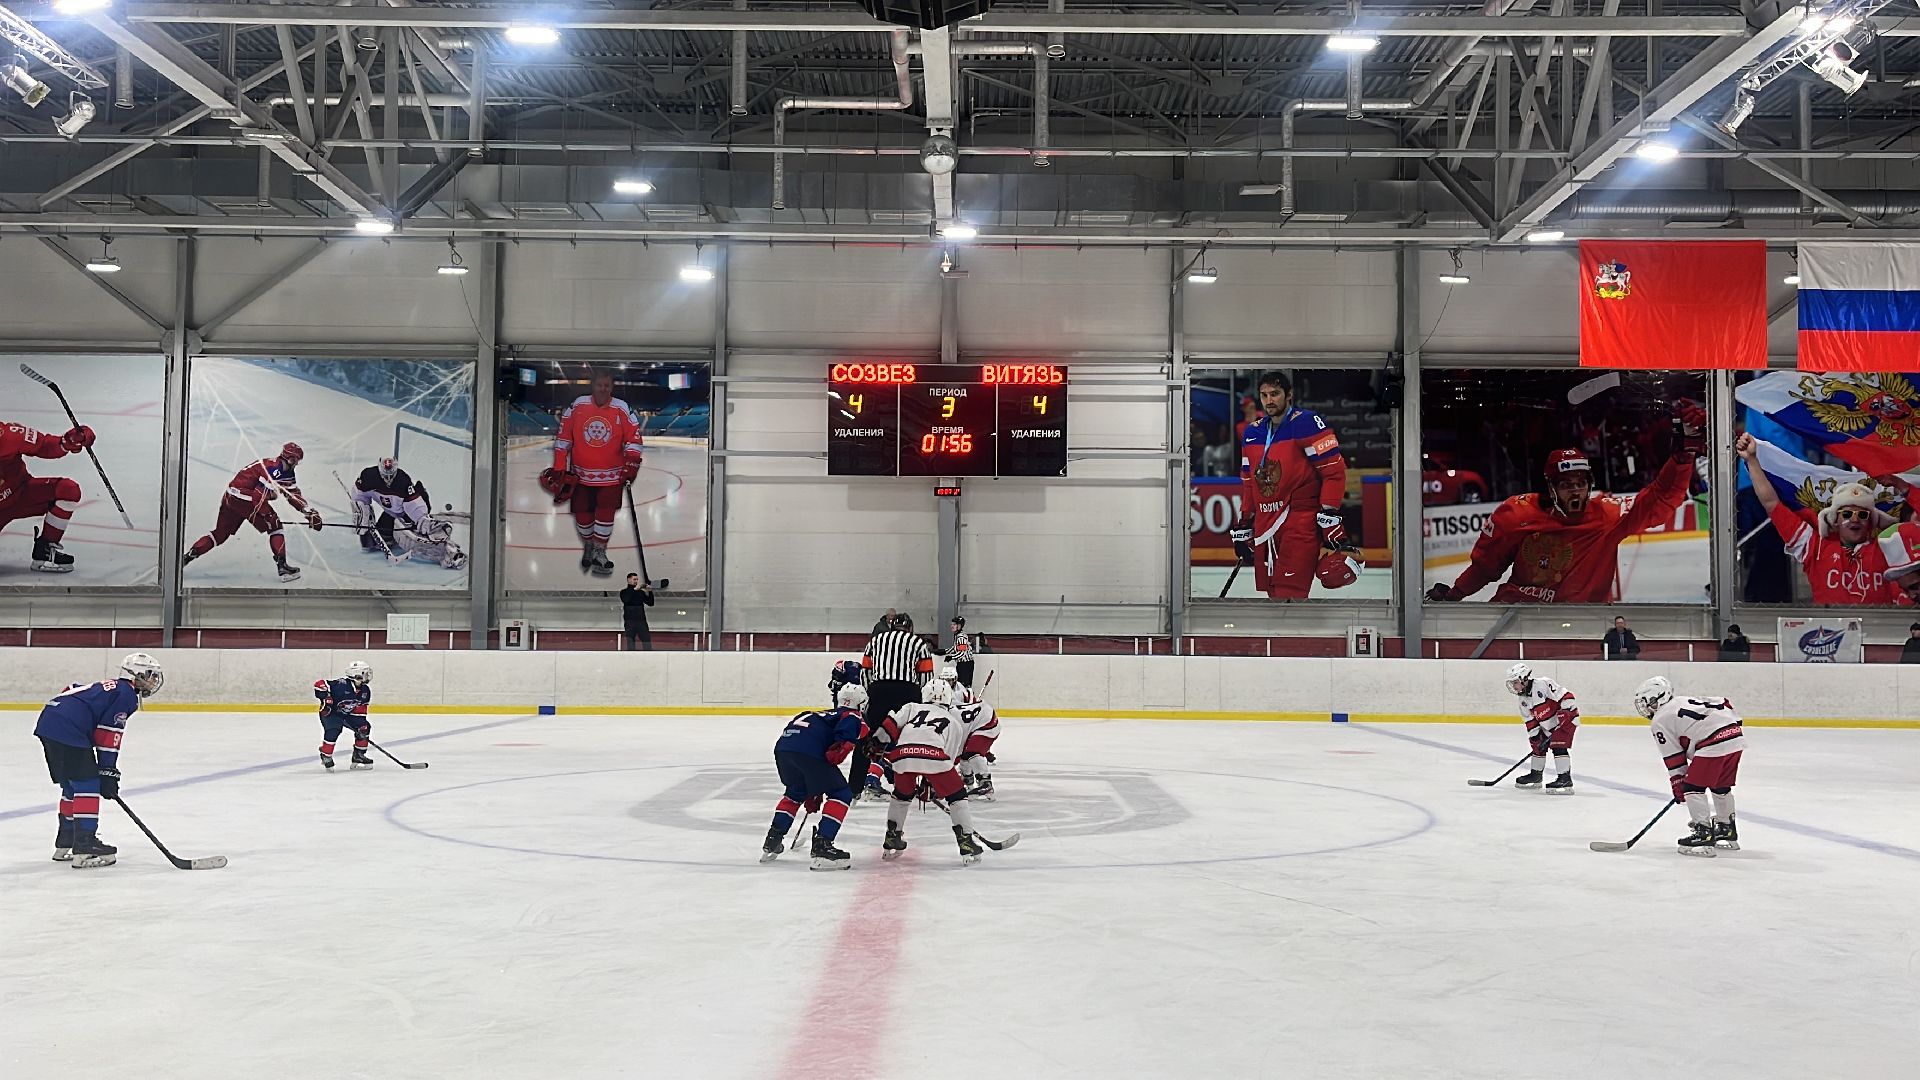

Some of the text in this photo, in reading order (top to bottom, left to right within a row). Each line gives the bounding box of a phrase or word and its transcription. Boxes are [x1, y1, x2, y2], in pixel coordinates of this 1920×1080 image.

[832, 364, 916, 382] СОЗВЕЗ
[982, 365, 1063, 383] ВИТЯЗЬ
[929, 388, 967, 397] ПЕРИОД
[849, 393, 863, 413] 4
[941, 397, 955, 418] 3
[1033, 395, 1047, 415] 4
[931, 426, 964, 434] ВРЕМЯ
[1313, 415, 1326, 430] 8
[834, 428, 884, 437] УДАЛЕНИЯ
[1010, 429, 1061, 438] УДАЛЕНИЯ
[921, 434, 973, 453] 01:56
[1826, 569, 1883, 591] СССР
[907, 709, 950, 735] 44
